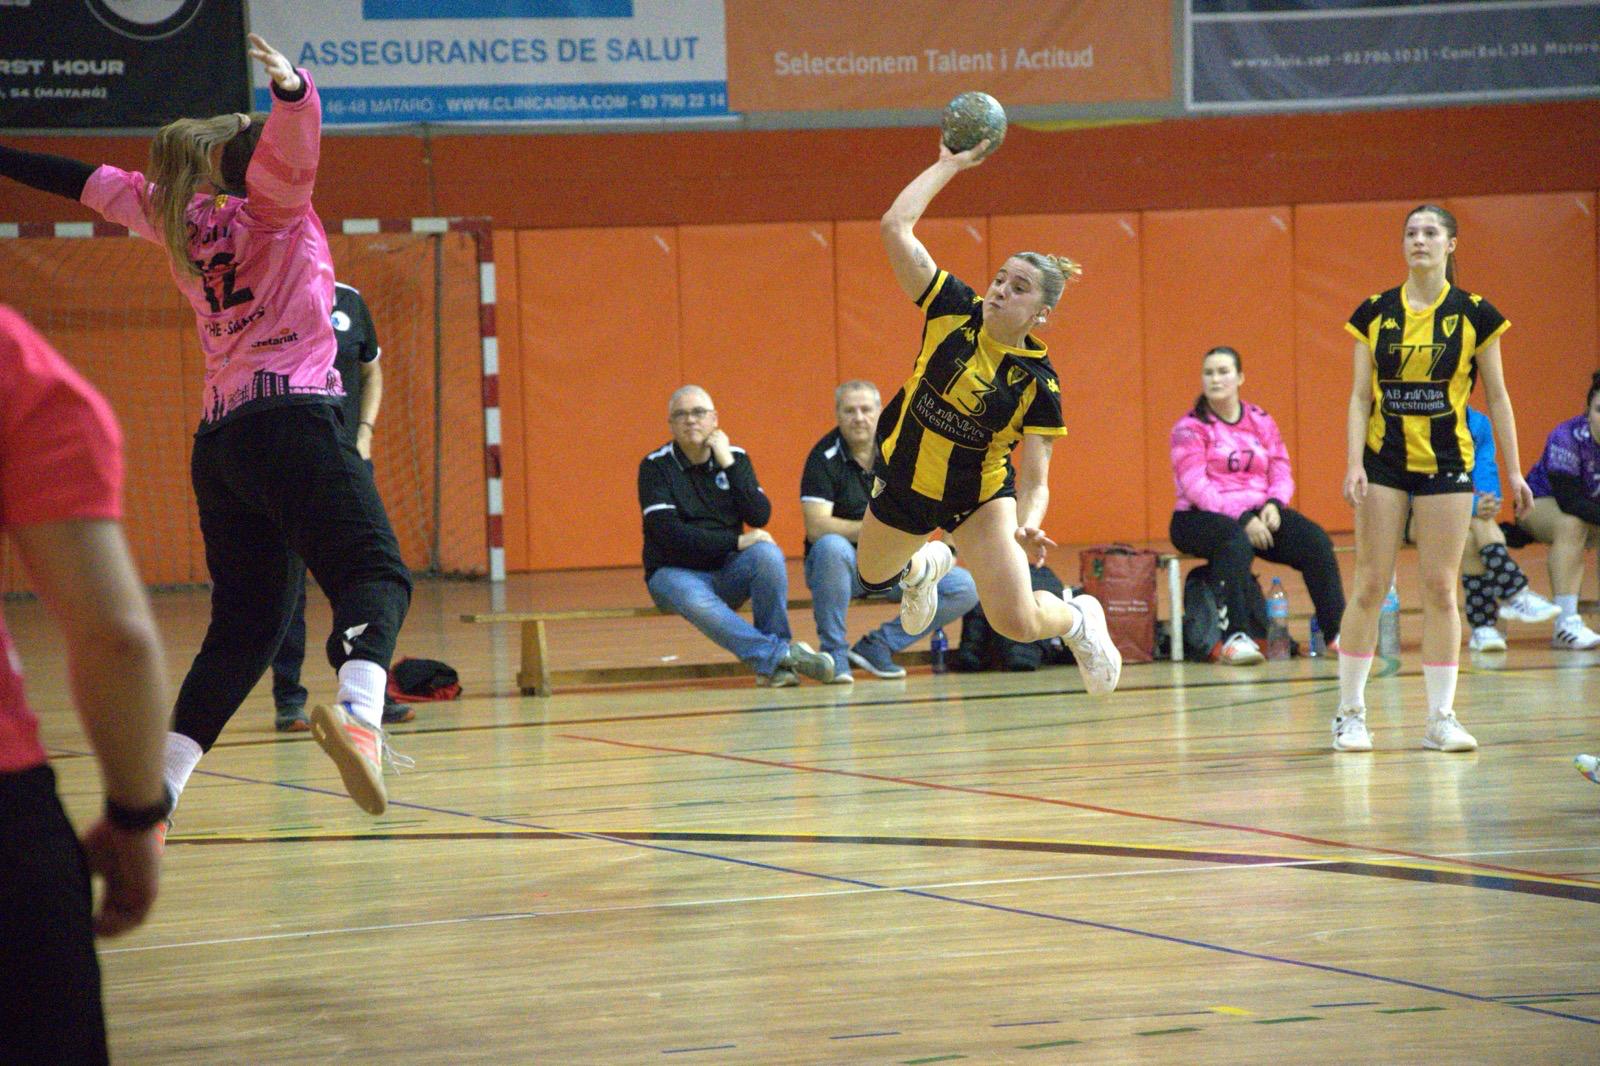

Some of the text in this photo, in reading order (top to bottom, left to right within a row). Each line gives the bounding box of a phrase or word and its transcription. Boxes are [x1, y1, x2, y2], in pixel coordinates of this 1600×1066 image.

[299, 36, 699, 66] ASSEGURANCES DE SALUT
[774, 46, 1094, 76] Seleccionem Talent i Actitud
[53, 60, 125, 76] HOUR
[1389, 344, 1446, 377] 77
[1388, 399, 1445, 410] nvestments
[1227, 450, 1254, 473] 67
